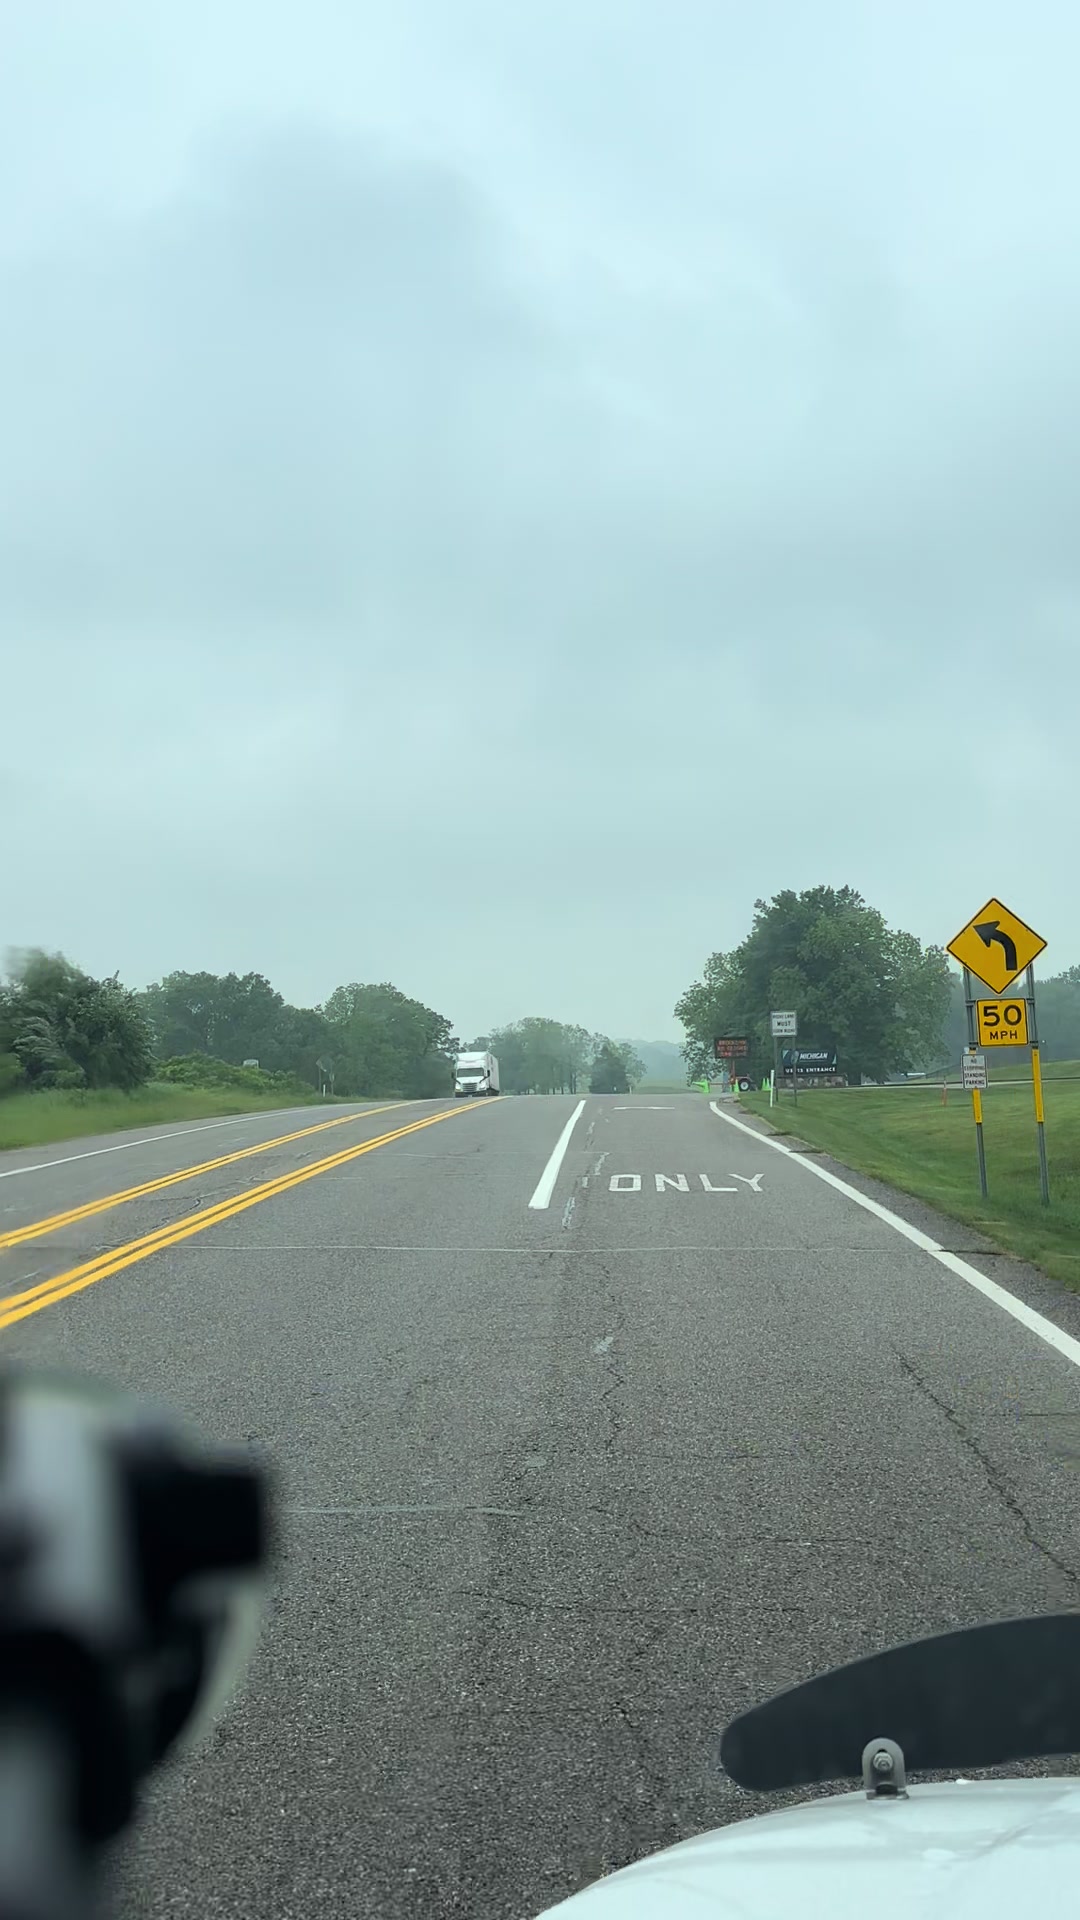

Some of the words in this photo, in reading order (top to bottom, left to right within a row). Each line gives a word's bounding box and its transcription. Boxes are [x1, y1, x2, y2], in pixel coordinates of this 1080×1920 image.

[983, 1004, 1022, 1027] 50
[990, 1030, 1018, 1040] MPH
[799, 1052, 828, 1060] MICHIGAN
[608, 1173, 765, 1192] ONLY
